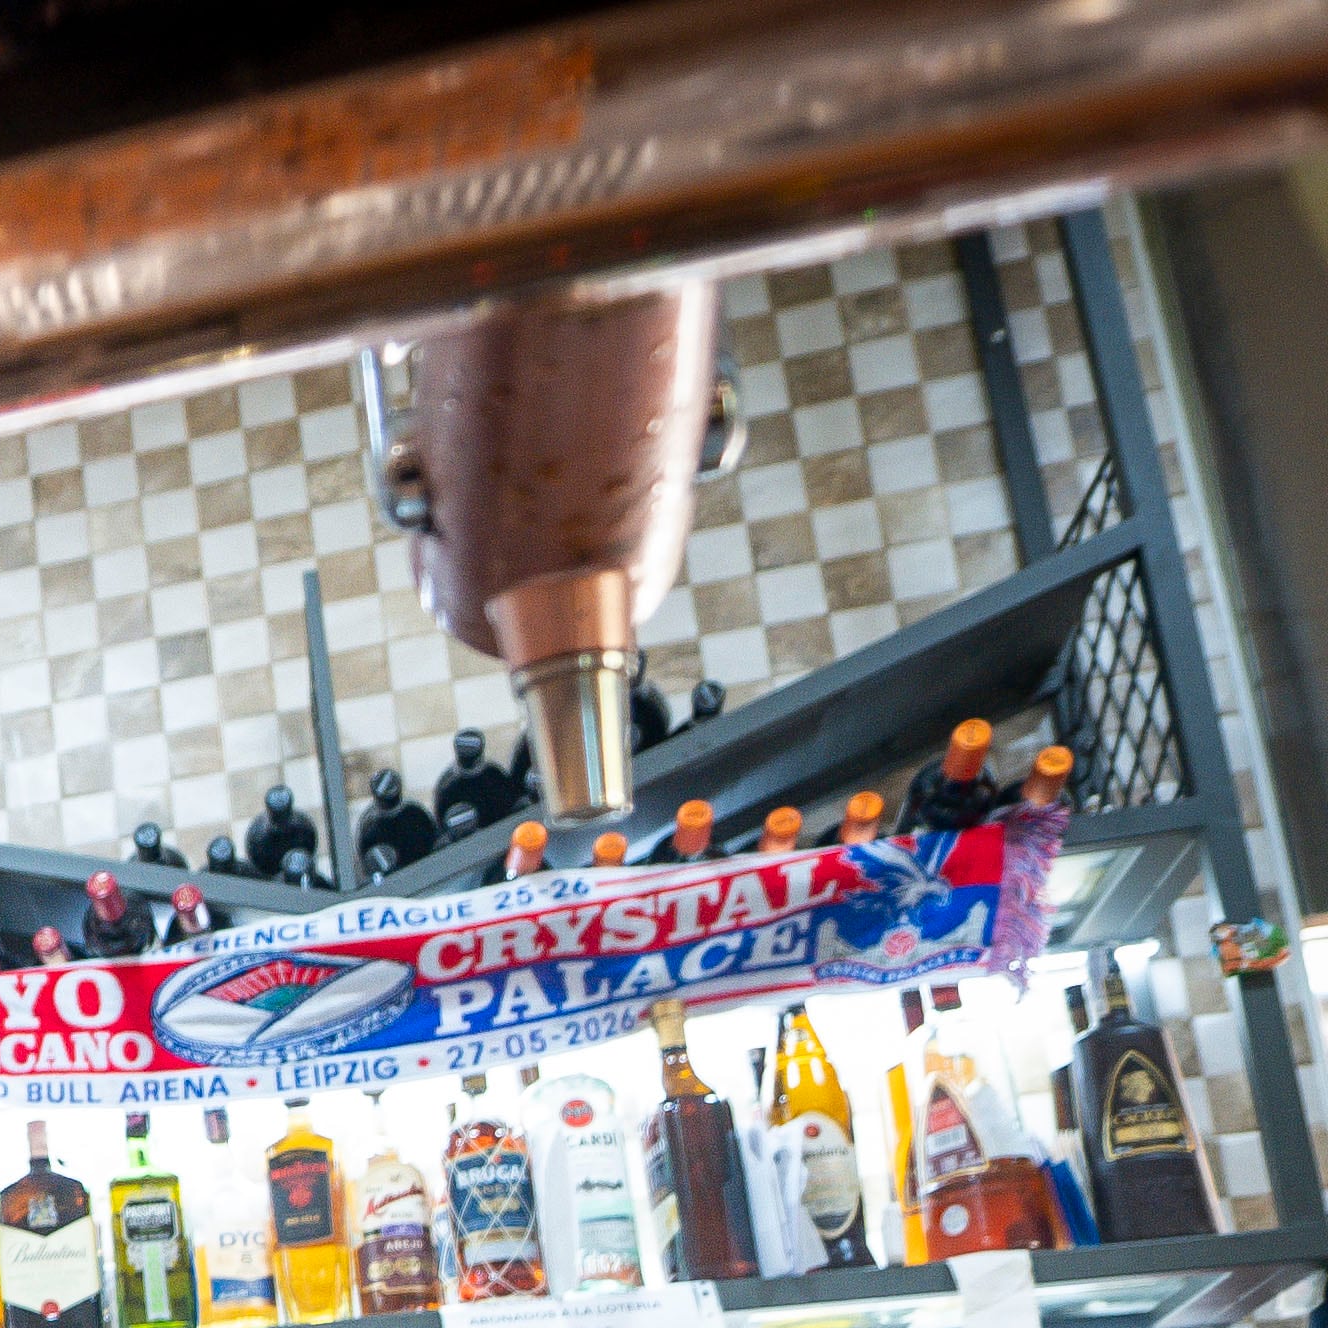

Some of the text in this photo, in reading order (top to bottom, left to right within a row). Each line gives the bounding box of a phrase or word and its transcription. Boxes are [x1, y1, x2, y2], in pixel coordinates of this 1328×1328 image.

[338, 898, 476, 935] LEAGUE
[494, 877, 591, 913] 25-26
[416, 848, 842, 980] CRYSTAL
[431, 911, 814, 1037] PALACE
[25, 1080, 100, 1104] BULL
[119, 1073, 229, 1104] ARENA
[275, 1056, 401, 1092] LEIPZIG
[445, 1006, 636, 1071] 27-05-2026
